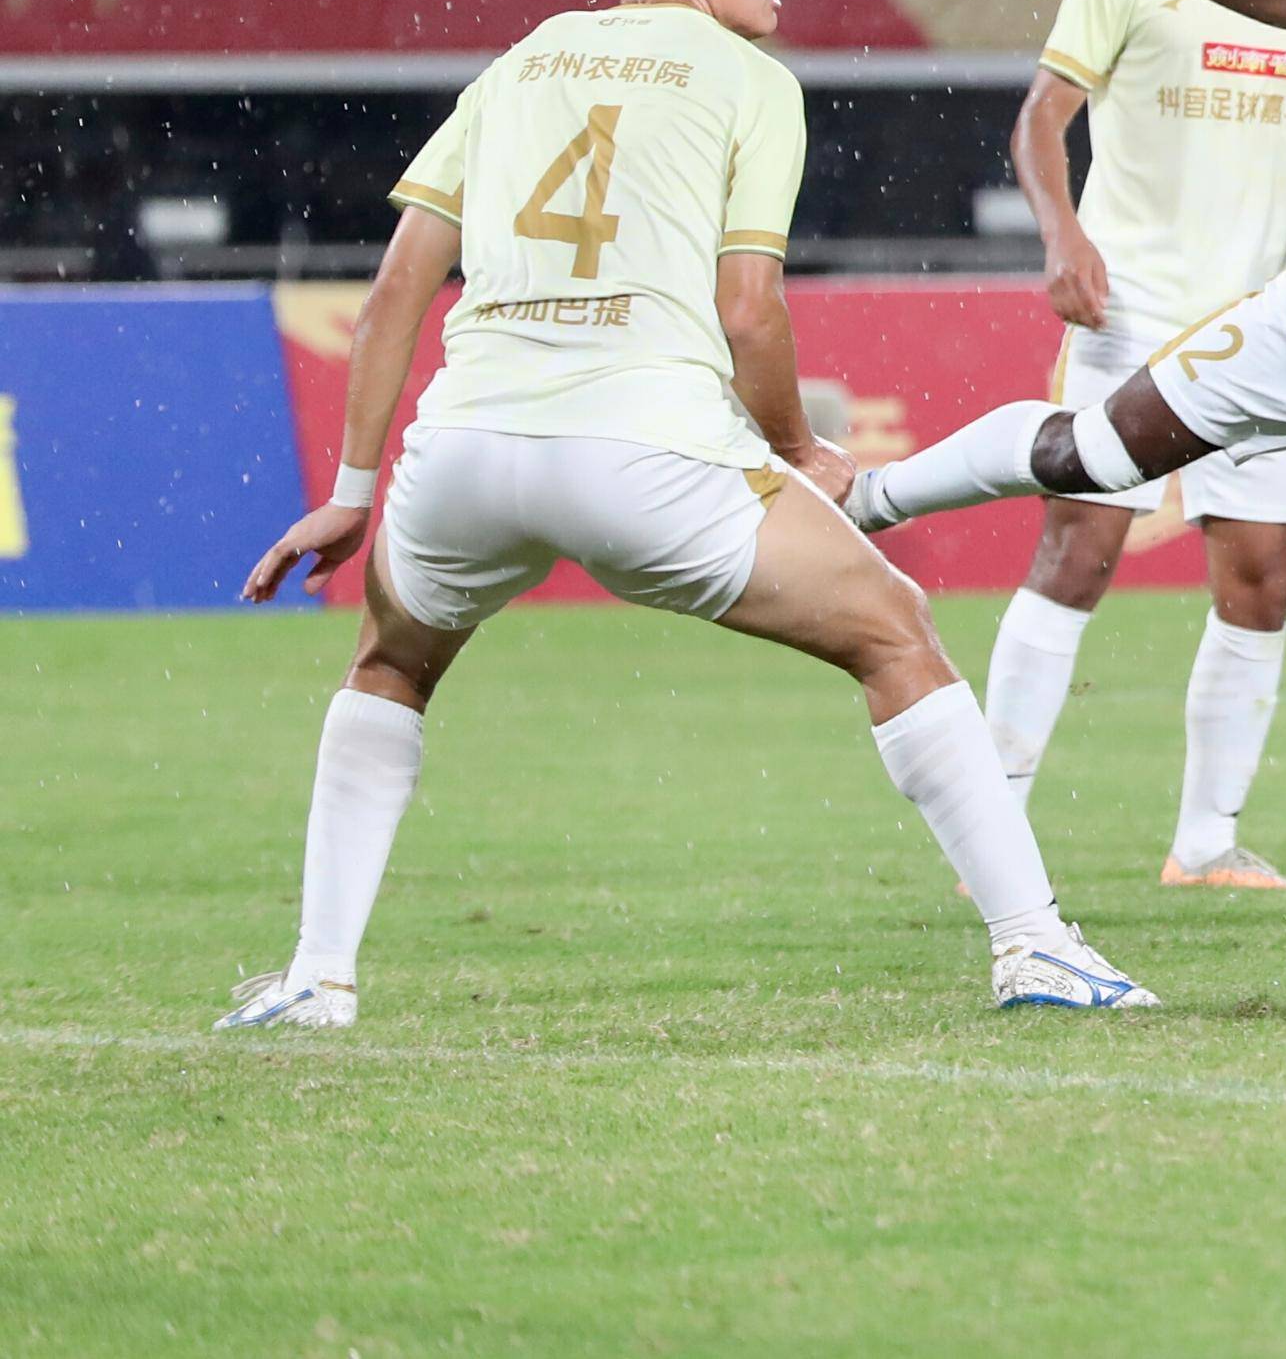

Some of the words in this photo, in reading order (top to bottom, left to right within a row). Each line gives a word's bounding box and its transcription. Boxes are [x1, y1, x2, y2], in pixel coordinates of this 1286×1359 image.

[517, 49, 695, 89] 苏州农职院
[513, 103, 623, 280] 4
[1176, 323, 1246, 383] 2
